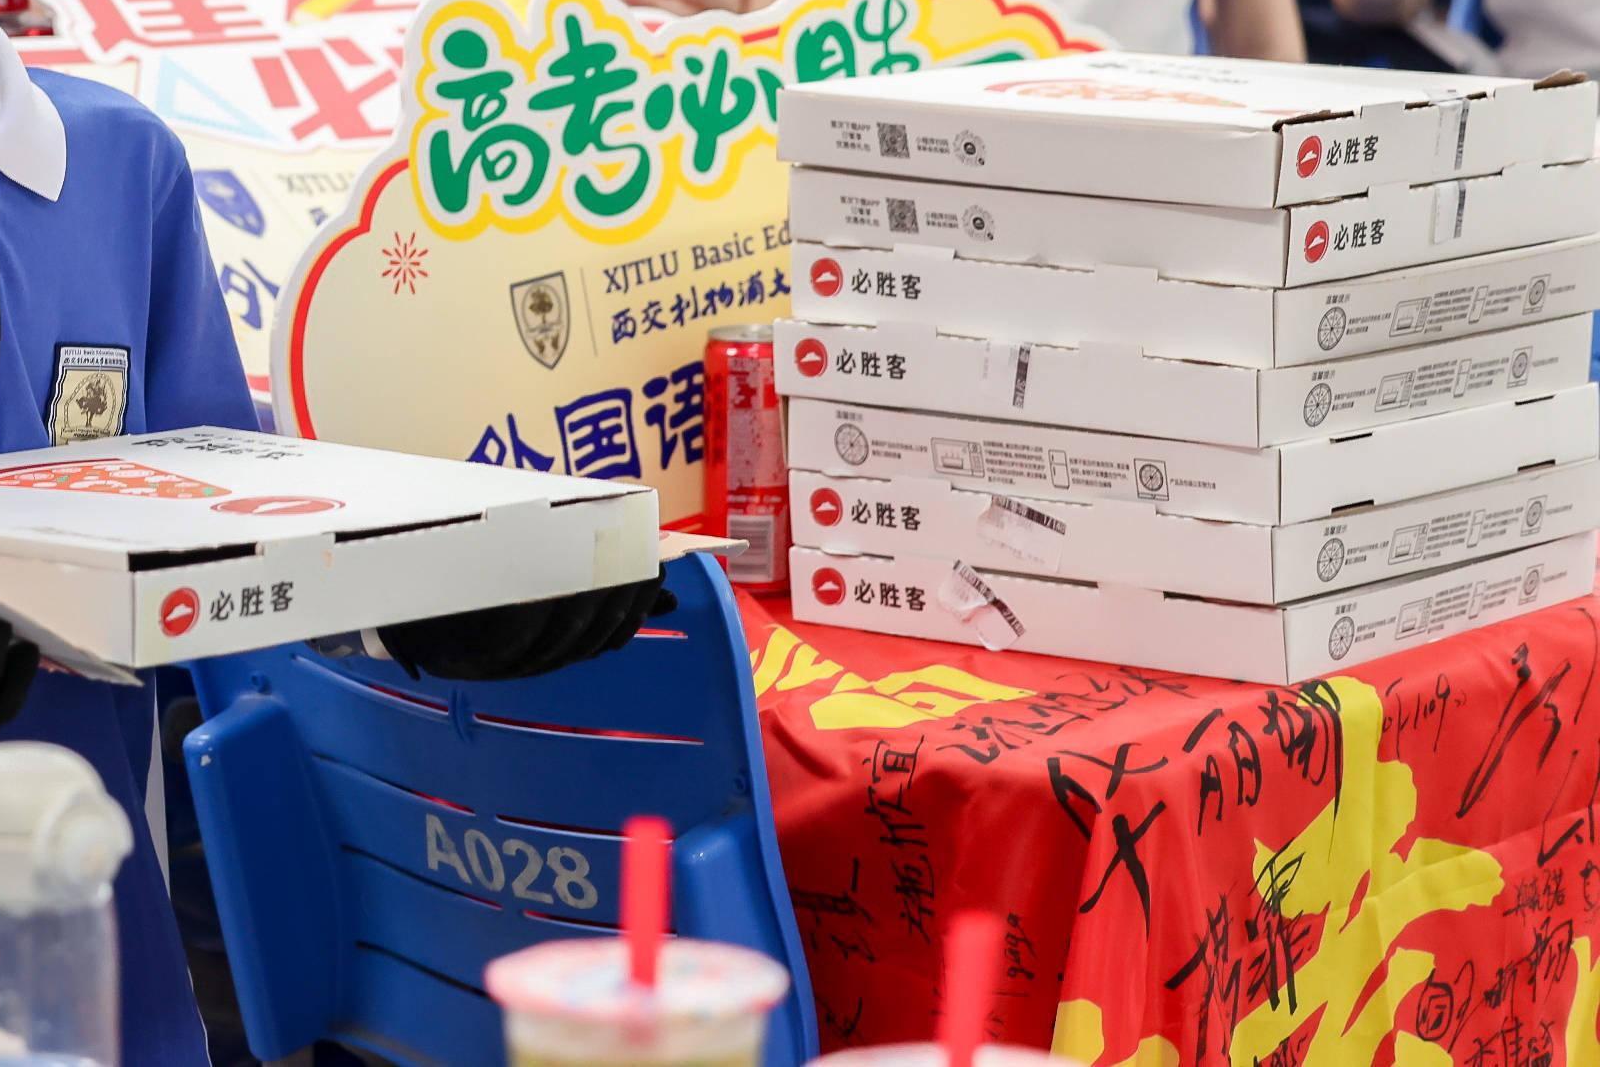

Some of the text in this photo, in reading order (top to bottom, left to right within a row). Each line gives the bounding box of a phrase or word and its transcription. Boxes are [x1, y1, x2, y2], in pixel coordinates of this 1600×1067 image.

[1326, 135, 1380, 168] 必胜客
[1332, 218, 1386, 252] 必胜客
[603, 251, 679, 294] XJTLU
[691, 232, 754, 271] Basic
[851, 268, 923, 302] 必胜客
[835, 347, 908, 381] 必胜客
[468, 360, 704, 479] 外国语
[850, 499, 922, 532] 必胜客
[208, 579, 295, 624] 必胜客
[853, 578, 927, 613] 必胜客
[425, 813, 600, 912] A028
